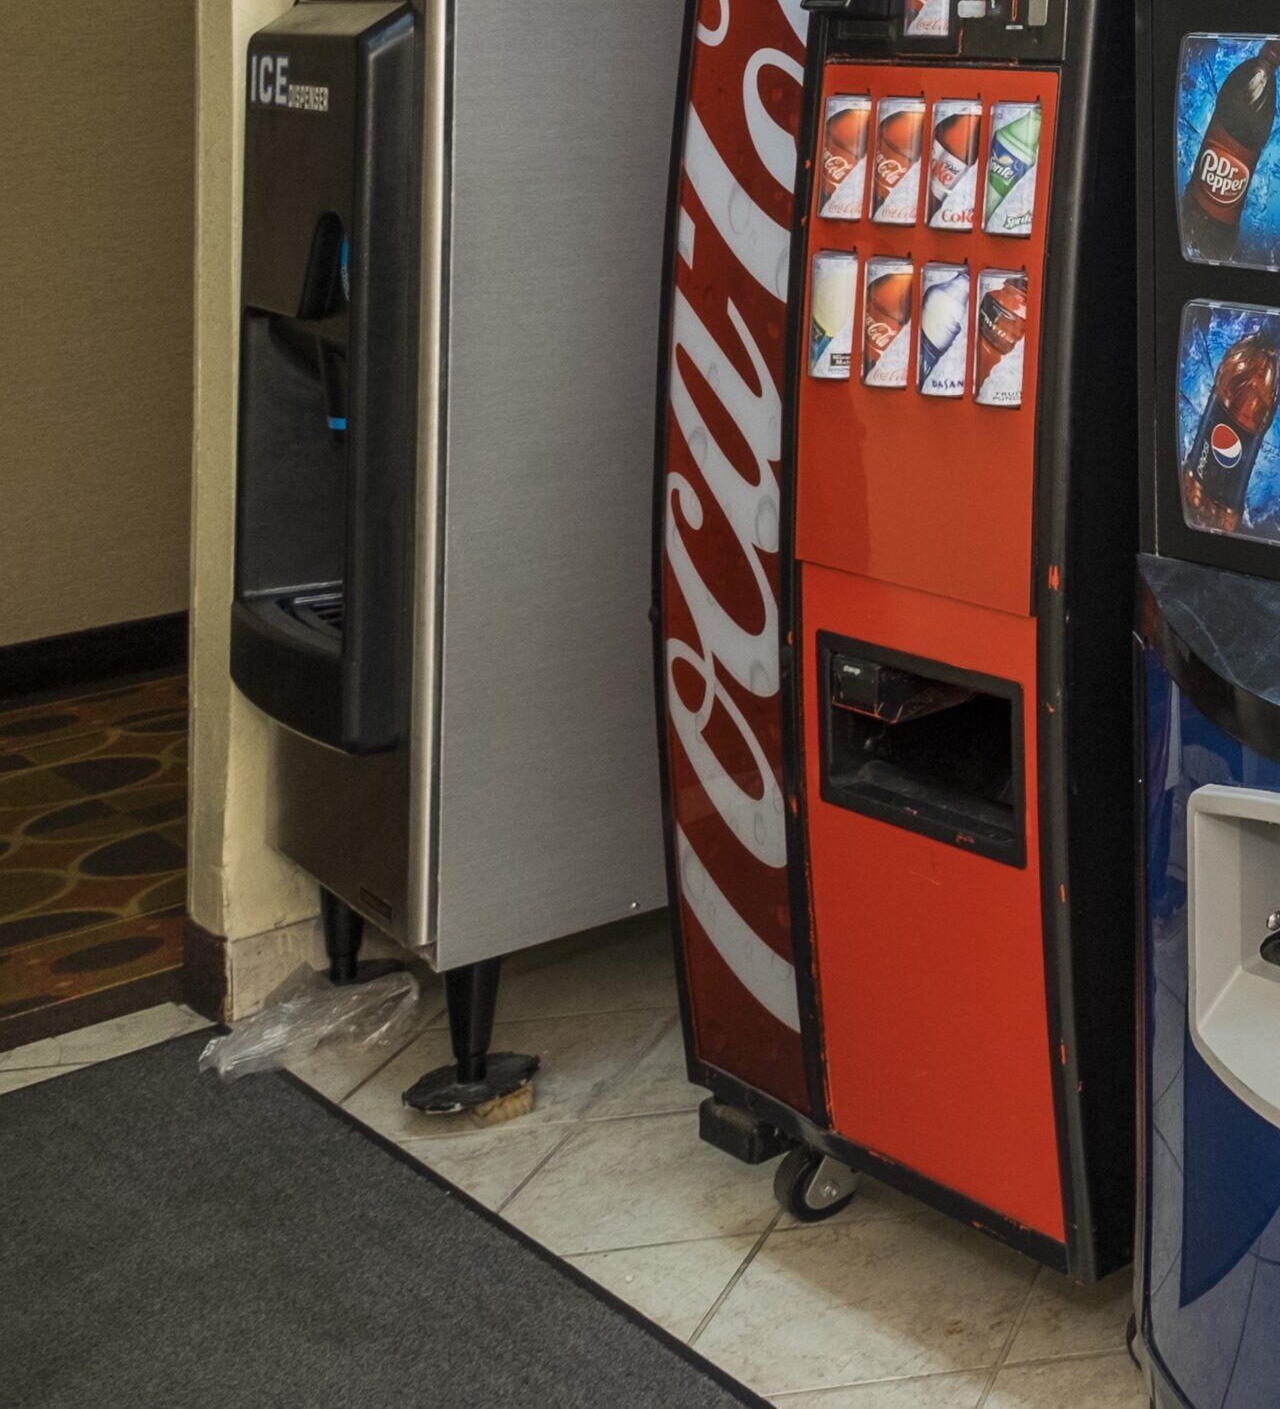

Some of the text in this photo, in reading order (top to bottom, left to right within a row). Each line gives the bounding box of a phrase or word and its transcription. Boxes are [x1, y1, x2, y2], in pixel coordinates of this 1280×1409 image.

[250, 55, 290, 106] ICE
[1200, 148, 1247, 194] Pepper
[1215, 155, 1240, 178] Dr
